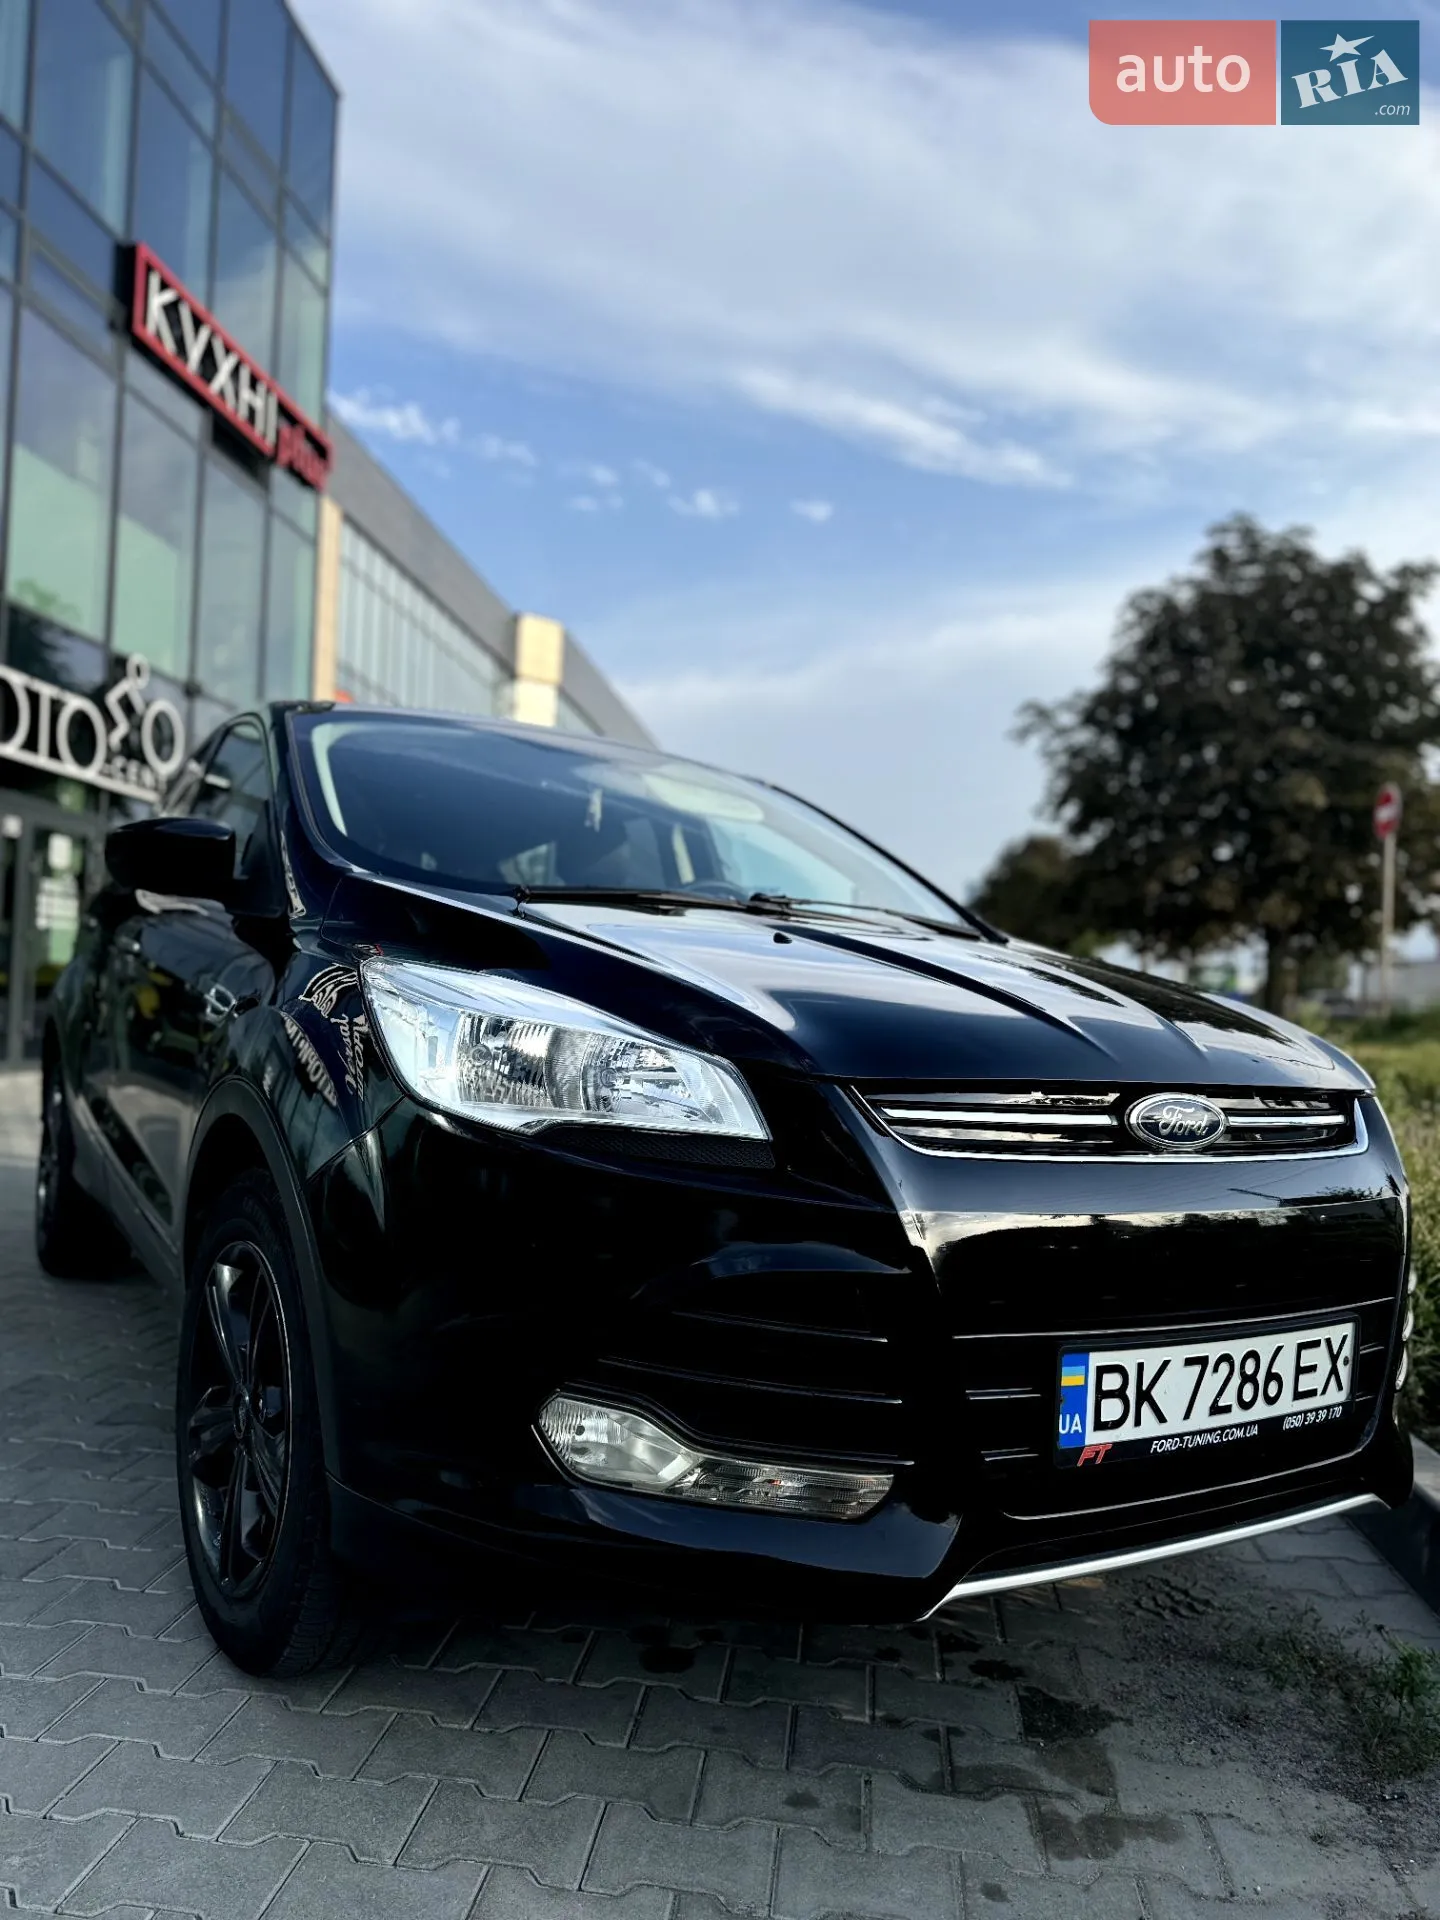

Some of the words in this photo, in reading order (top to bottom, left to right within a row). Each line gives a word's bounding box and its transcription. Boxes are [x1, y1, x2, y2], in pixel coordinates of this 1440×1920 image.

[146, 270, 278, 450] КУХНІ
[1159, 1105, 1208, 1136] Ford
[1093, 1359, 1171, 1432] BK
[1182, 1344, 1285, 1421] 7286
[1292, 1333, 1349, 1401] EX
[1059, 1413, 1082, 1434] UA
[1282, 1414, 1304, 1431] (050)
[1304, 1412, 1315, 1425] 39
[1316, 1409, 1327, 1422] 39
[1328, 1405, 1343, 1420] 170
[1150, 1424, 1258, 1454] FORD-TUNING.COM.UA
[1077, 1443, 1113, 1467] FT
